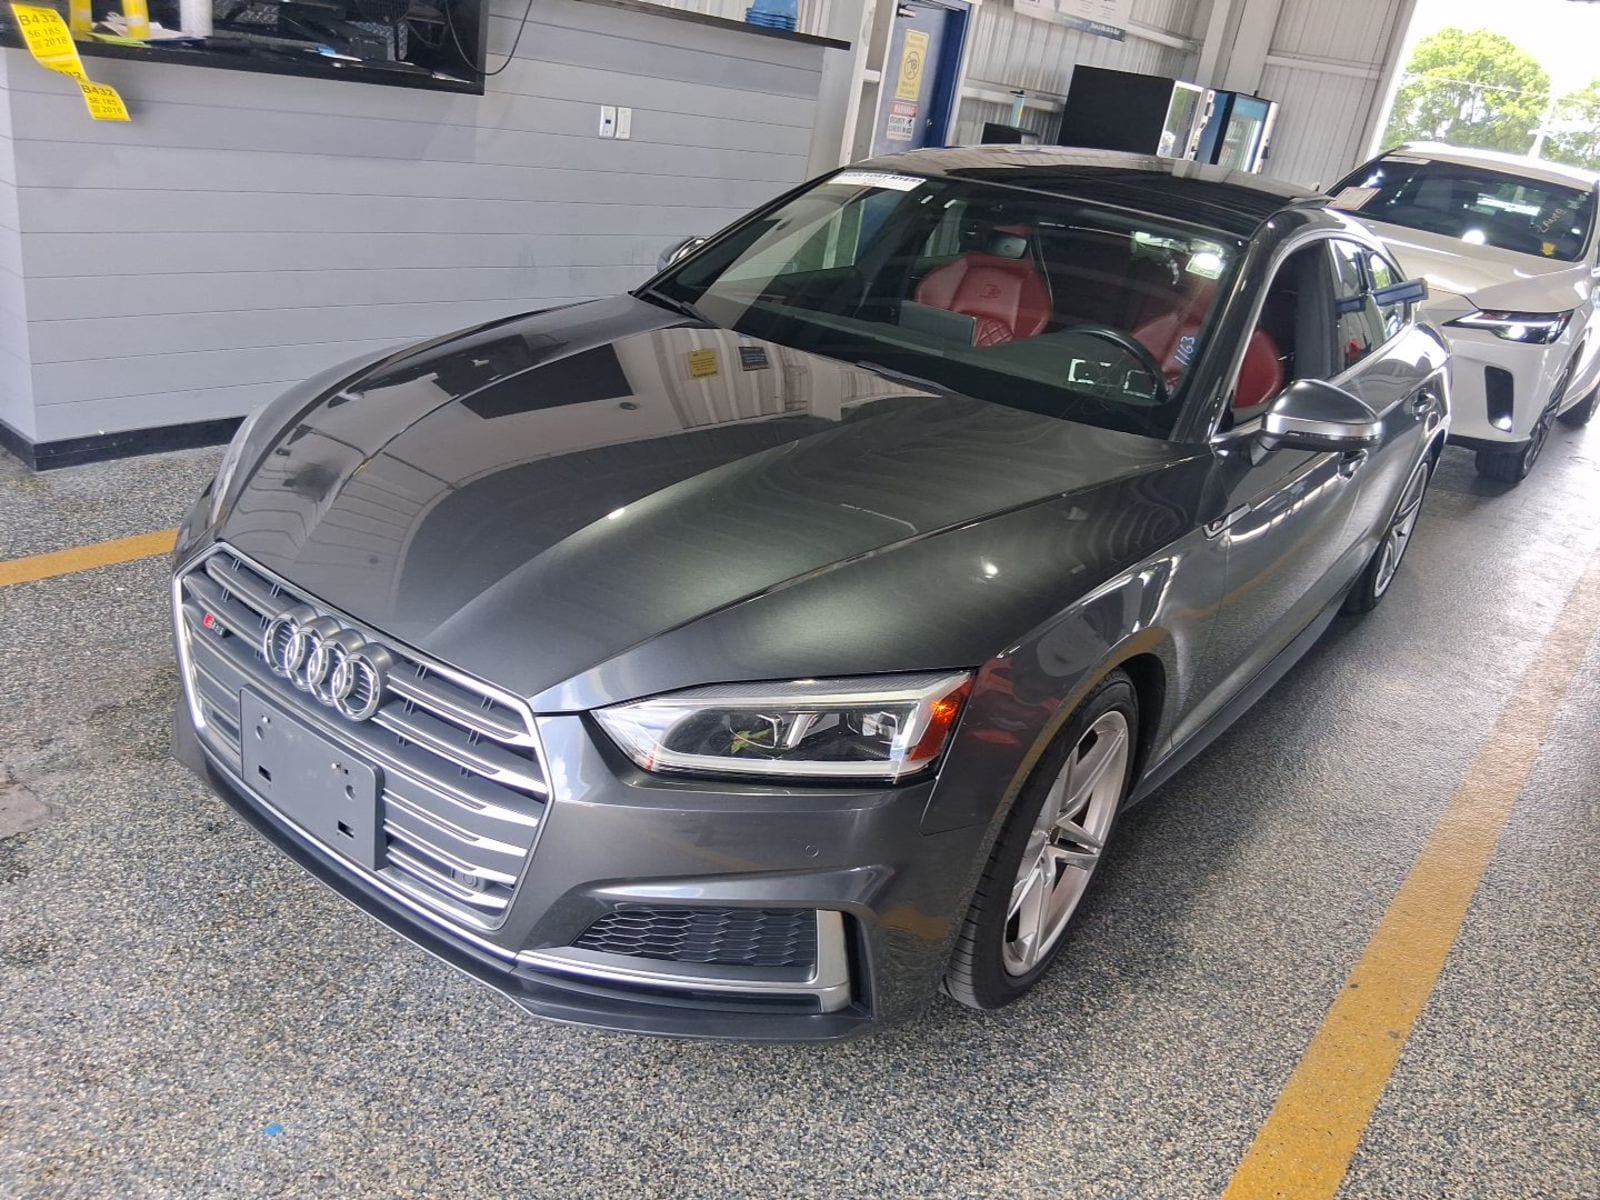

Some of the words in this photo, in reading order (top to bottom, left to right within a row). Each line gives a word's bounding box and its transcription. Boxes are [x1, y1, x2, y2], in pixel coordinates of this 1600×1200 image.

[19, 13, 58, 26] B432
[82, 84, 114, 96] B432
[1174, 335, 1195, 366] 1163
